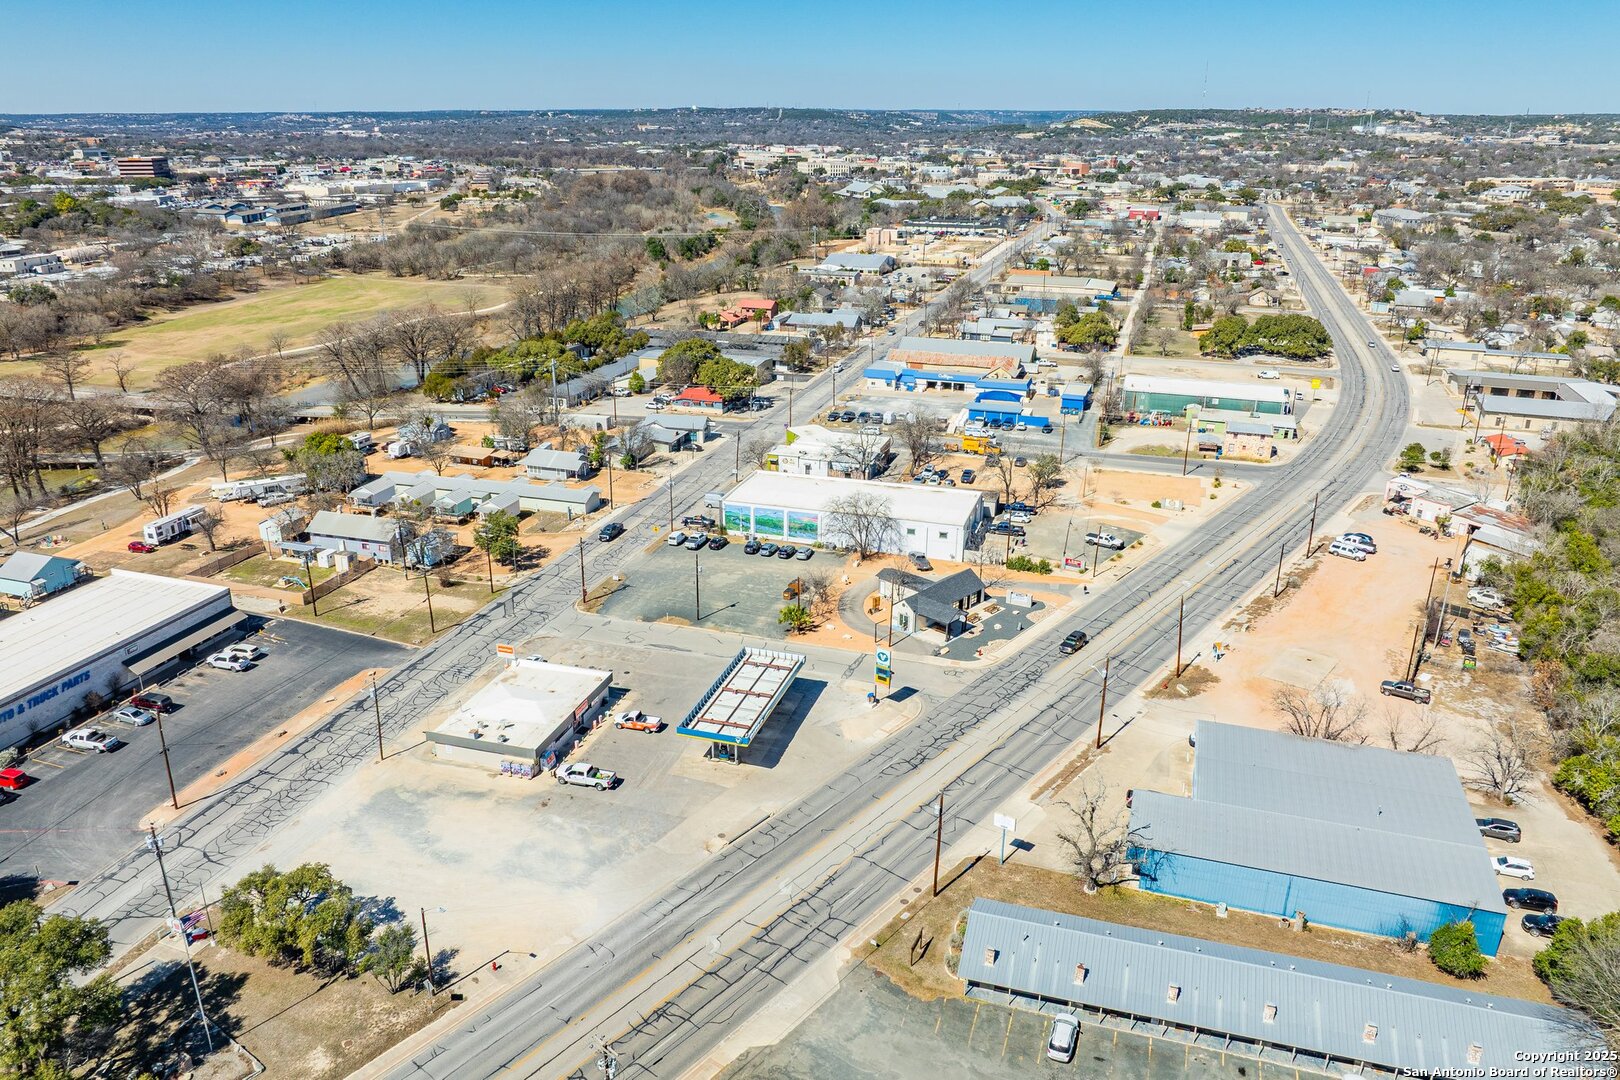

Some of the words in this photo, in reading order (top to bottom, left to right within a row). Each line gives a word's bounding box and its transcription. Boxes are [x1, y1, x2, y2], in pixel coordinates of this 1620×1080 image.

[0, 708, 14, 722] TO
[17, 703, 25, 715] &
[27, 686, 59, 709] TRUCK
[62, 670, 91, 692] PARTS
